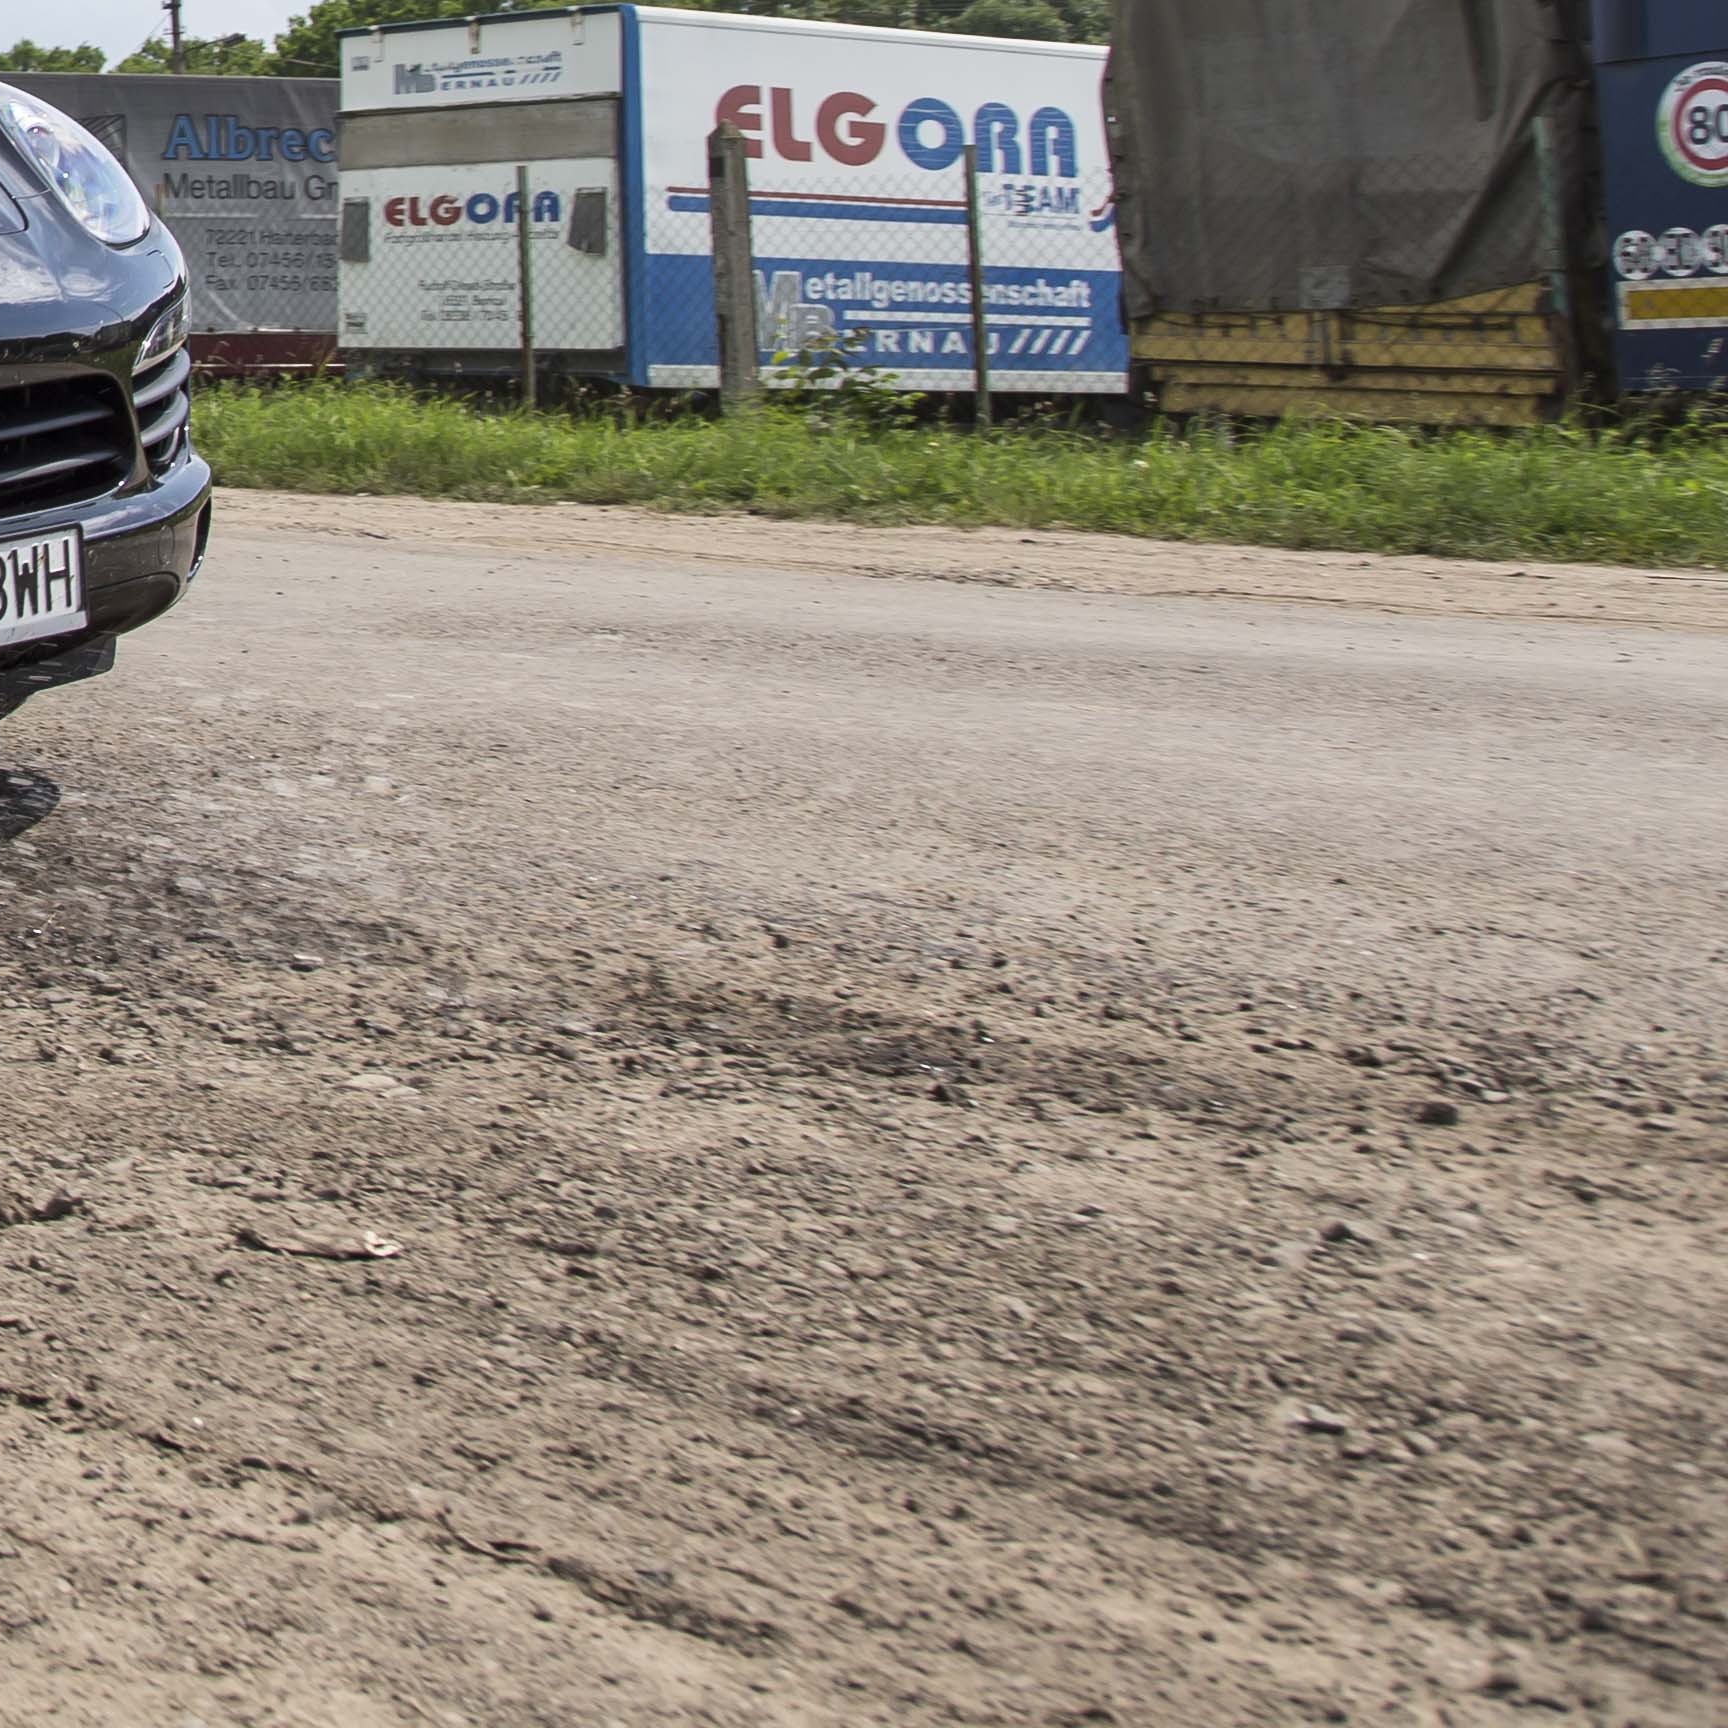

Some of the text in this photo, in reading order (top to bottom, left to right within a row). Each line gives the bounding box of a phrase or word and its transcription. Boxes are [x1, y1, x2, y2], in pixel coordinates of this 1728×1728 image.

[160, 113, 338, 163] Albrec
[715, 84, 1078, 178] ELGORA
[1689, 103, 1728, 146] 80
[163, 173, 296, 200] Metallbau
